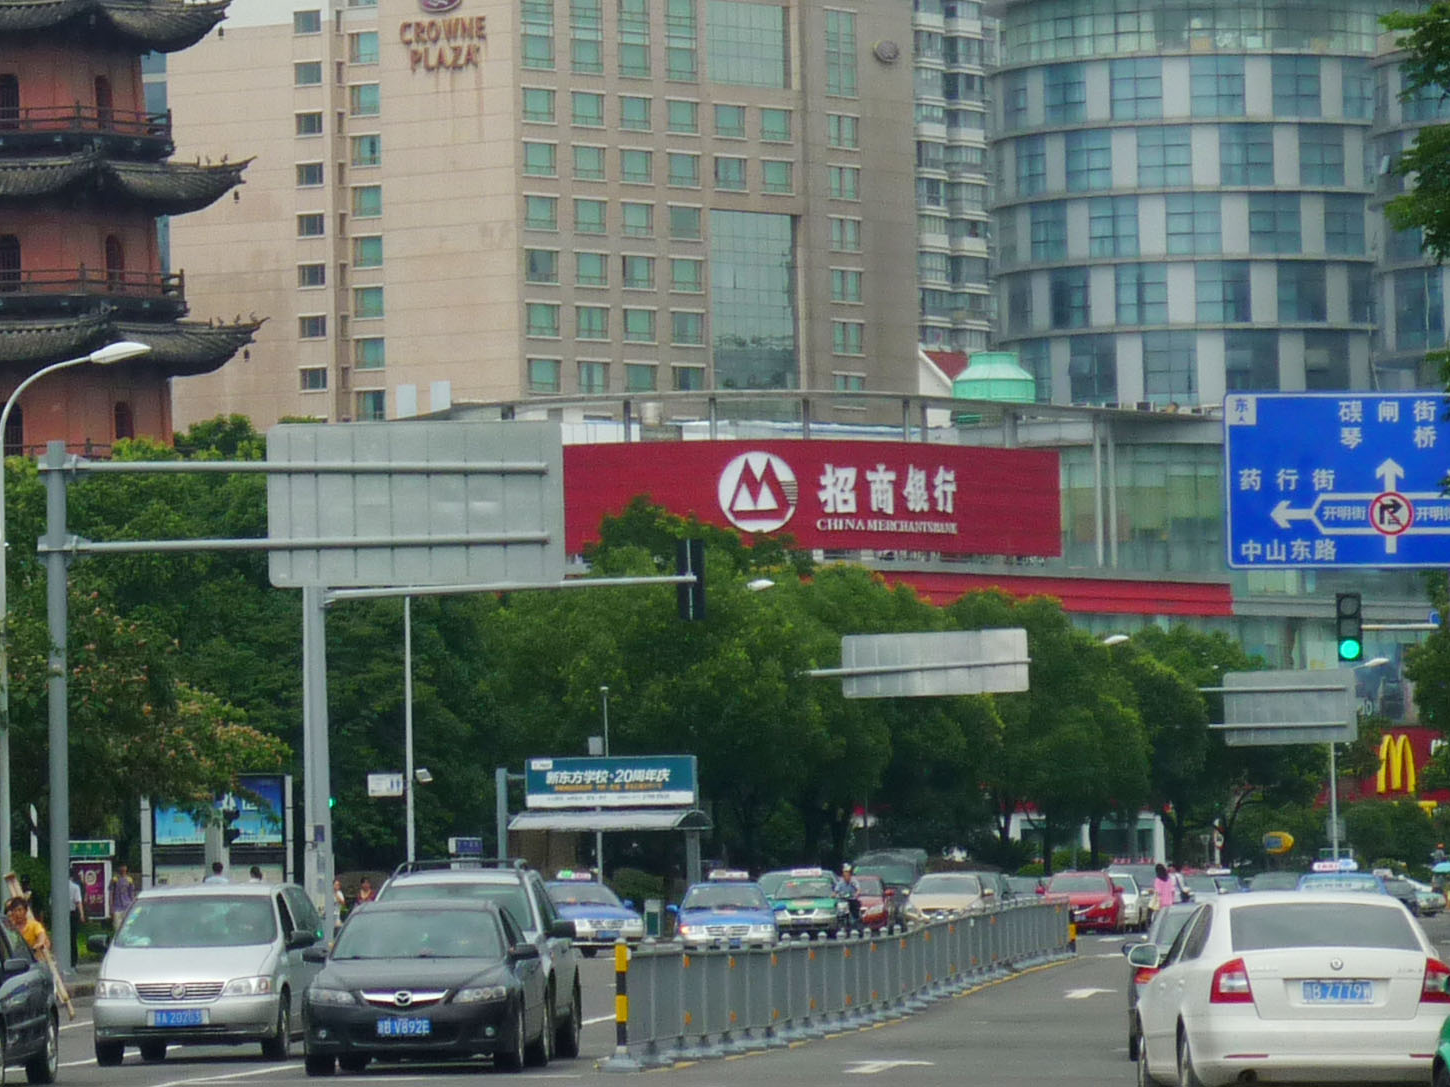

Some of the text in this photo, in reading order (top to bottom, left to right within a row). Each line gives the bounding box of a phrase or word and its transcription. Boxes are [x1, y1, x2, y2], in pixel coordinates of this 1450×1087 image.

[399, 15, 487, 46] CROWNE
[410, 44, 480, 74] PLAZA
[1234, 398, 1250, 413] 东
[817, 463, 958, 515] 招商银行
[1239, 468, 1336, 492] 药行街
[816, 518, 865, 532] CHINA
[1322, 505, 1367, 522] 开明街
[1241, 538, 1337, 562] 中山东路
